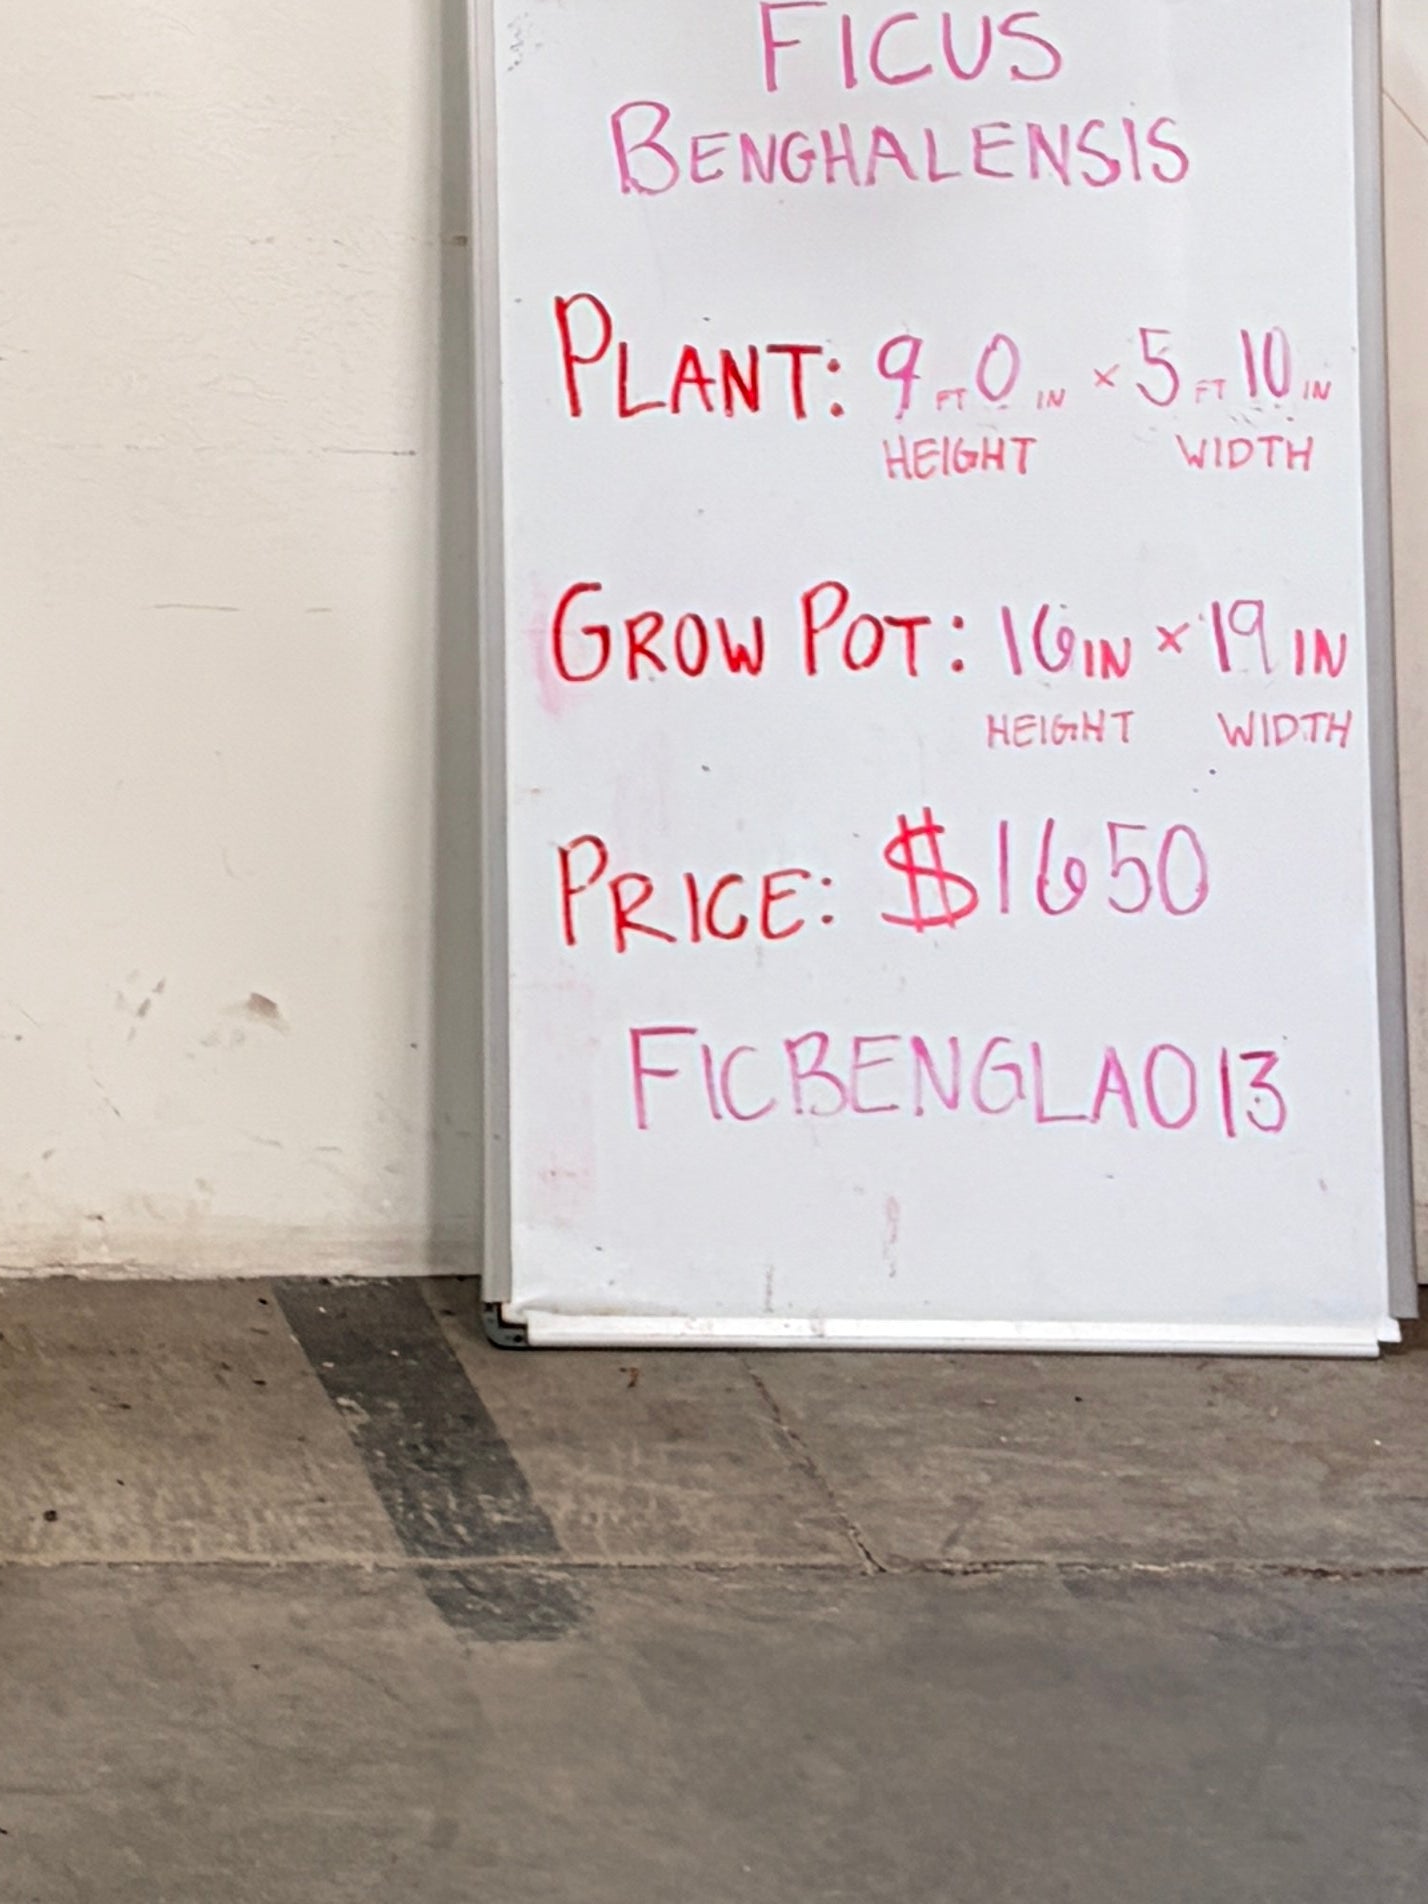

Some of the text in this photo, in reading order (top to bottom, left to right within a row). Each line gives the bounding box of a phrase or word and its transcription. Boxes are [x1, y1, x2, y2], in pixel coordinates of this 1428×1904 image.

[760, 0, 1064, 91] FICUS
[610, 100, 1191, 195] BENGHALENSIS
[553, 291, 844, 418] PLANT:
[1135, 327, 1180, 405] 5
[1239, 325, 1292, 399] 10
[883, 434, 1314, 480] HEIGHT WIDTH
[551, 581, 766, 687] GROW
[800, 580, 966, 680] POT:
[1294, 629, 1346, 678] IN
[987, 711, 1353, 749] HEIGHT WIDTH
[557, 807, 1210, 953] PRICE: $1650
[629, 1026, 1288, 1137] FICBENGLA013
